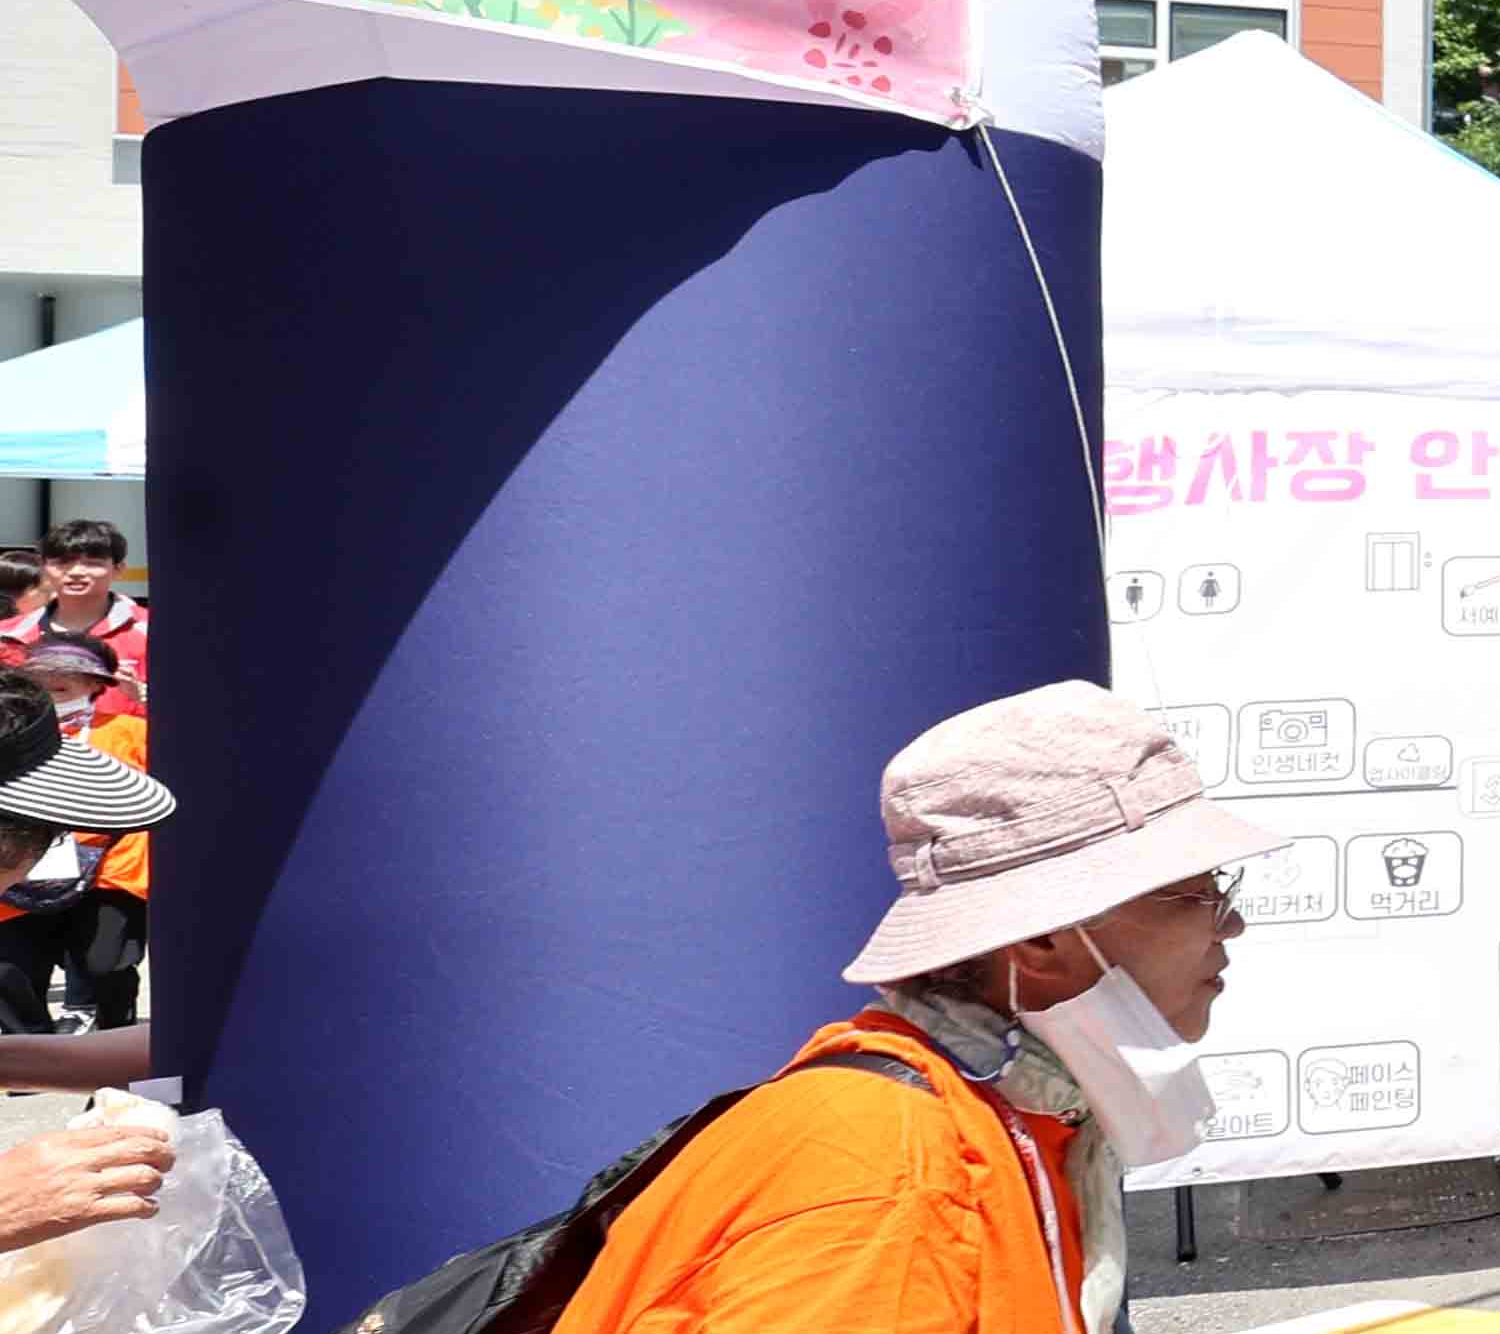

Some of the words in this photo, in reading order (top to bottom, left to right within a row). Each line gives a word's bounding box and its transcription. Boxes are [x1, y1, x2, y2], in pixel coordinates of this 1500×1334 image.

[1103, 429, 1376, 516] 행사장
[1252, 752, 1340, 776] 인생네컷
[1370, 890, 1440, 914] 먹거리
[1349, 1060, 1415, 1085] 페이스
[1349, 1088, 1415, 1112] 페인팅
[1205, 1111, 1273, 1137] 일아트
